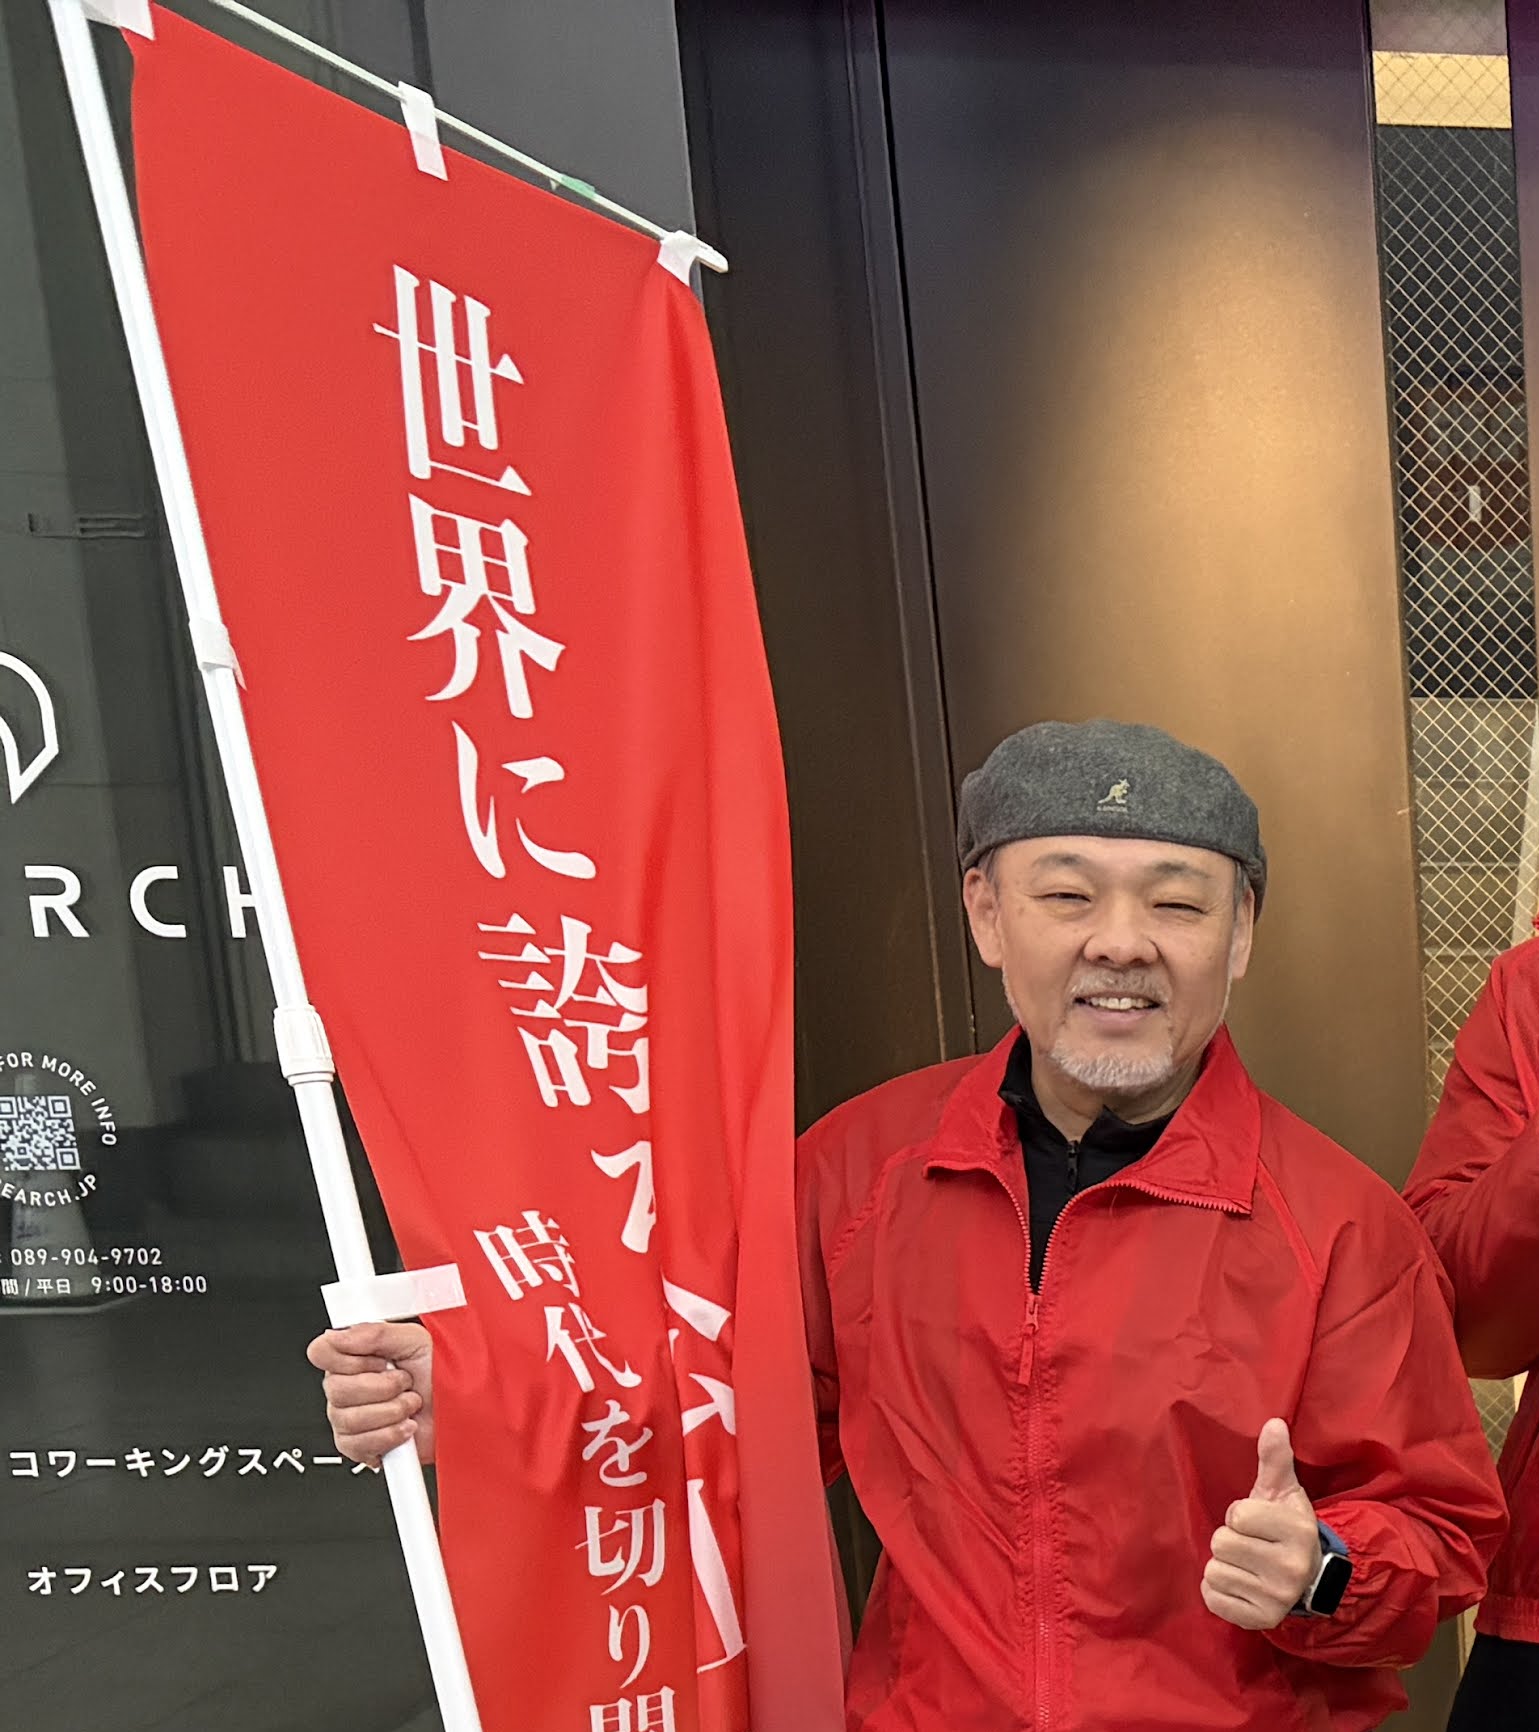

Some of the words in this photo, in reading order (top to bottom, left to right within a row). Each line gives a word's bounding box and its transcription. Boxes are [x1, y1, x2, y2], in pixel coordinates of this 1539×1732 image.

[41, 1055, 97, 1096] MORE
[91, 1097, 118, 1146] INFO
[0, 1173, 97, 1207] EARCH.JP
[10, 1247, 163, 1266] 089-904-9702
[90, 1275, 208, 1294] 9:00-18:00
[26, 1563, 279, 1597] オフィスフロア
